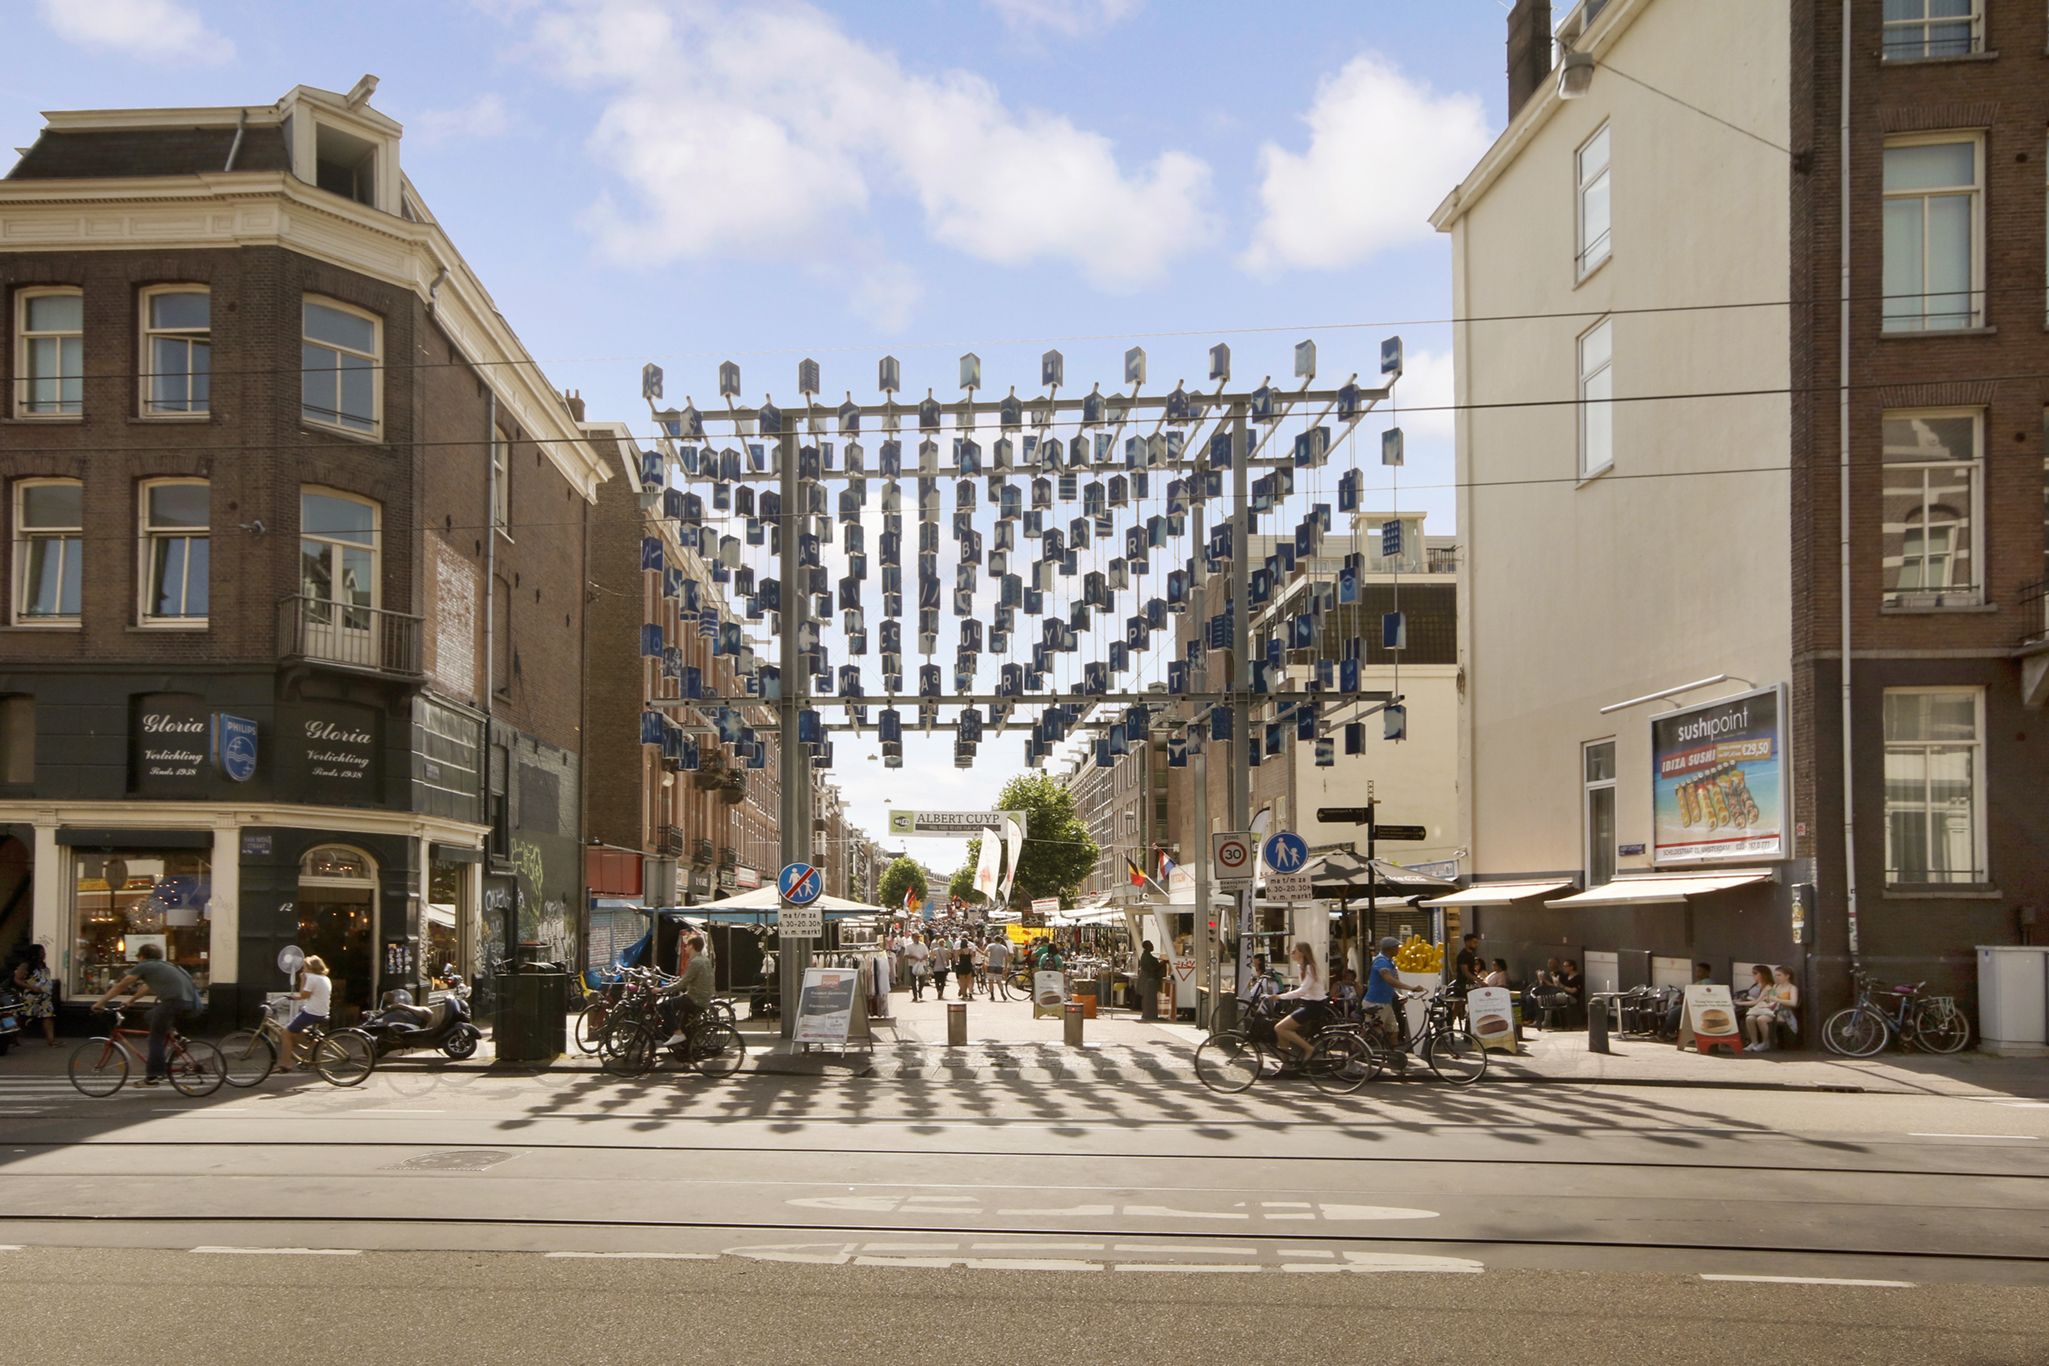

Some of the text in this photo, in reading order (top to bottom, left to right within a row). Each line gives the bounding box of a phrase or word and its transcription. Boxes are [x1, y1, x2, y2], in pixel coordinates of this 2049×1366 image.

[143, 714, 205, 733] Gloria
[227, 721, 257, 736] PHILIPS
[1678, 706, 1748, 742] sushipoint
[304, 720, 372, 744] Gloria
[144, 750, 204, 765] Verlichting
[306, 750, 370, 769] Verlichting
[1662, 757, 1686, 773] IBIZA
[1688, 749, 1716, 766] SUSHI
[916, 813, 1000, 824] ALBERT CUYP
[1225, 849, 1241, 860] 30
[1267, 885, 1311, 893] 6.30-20.30h
[279, 902, 293, 912] 12
